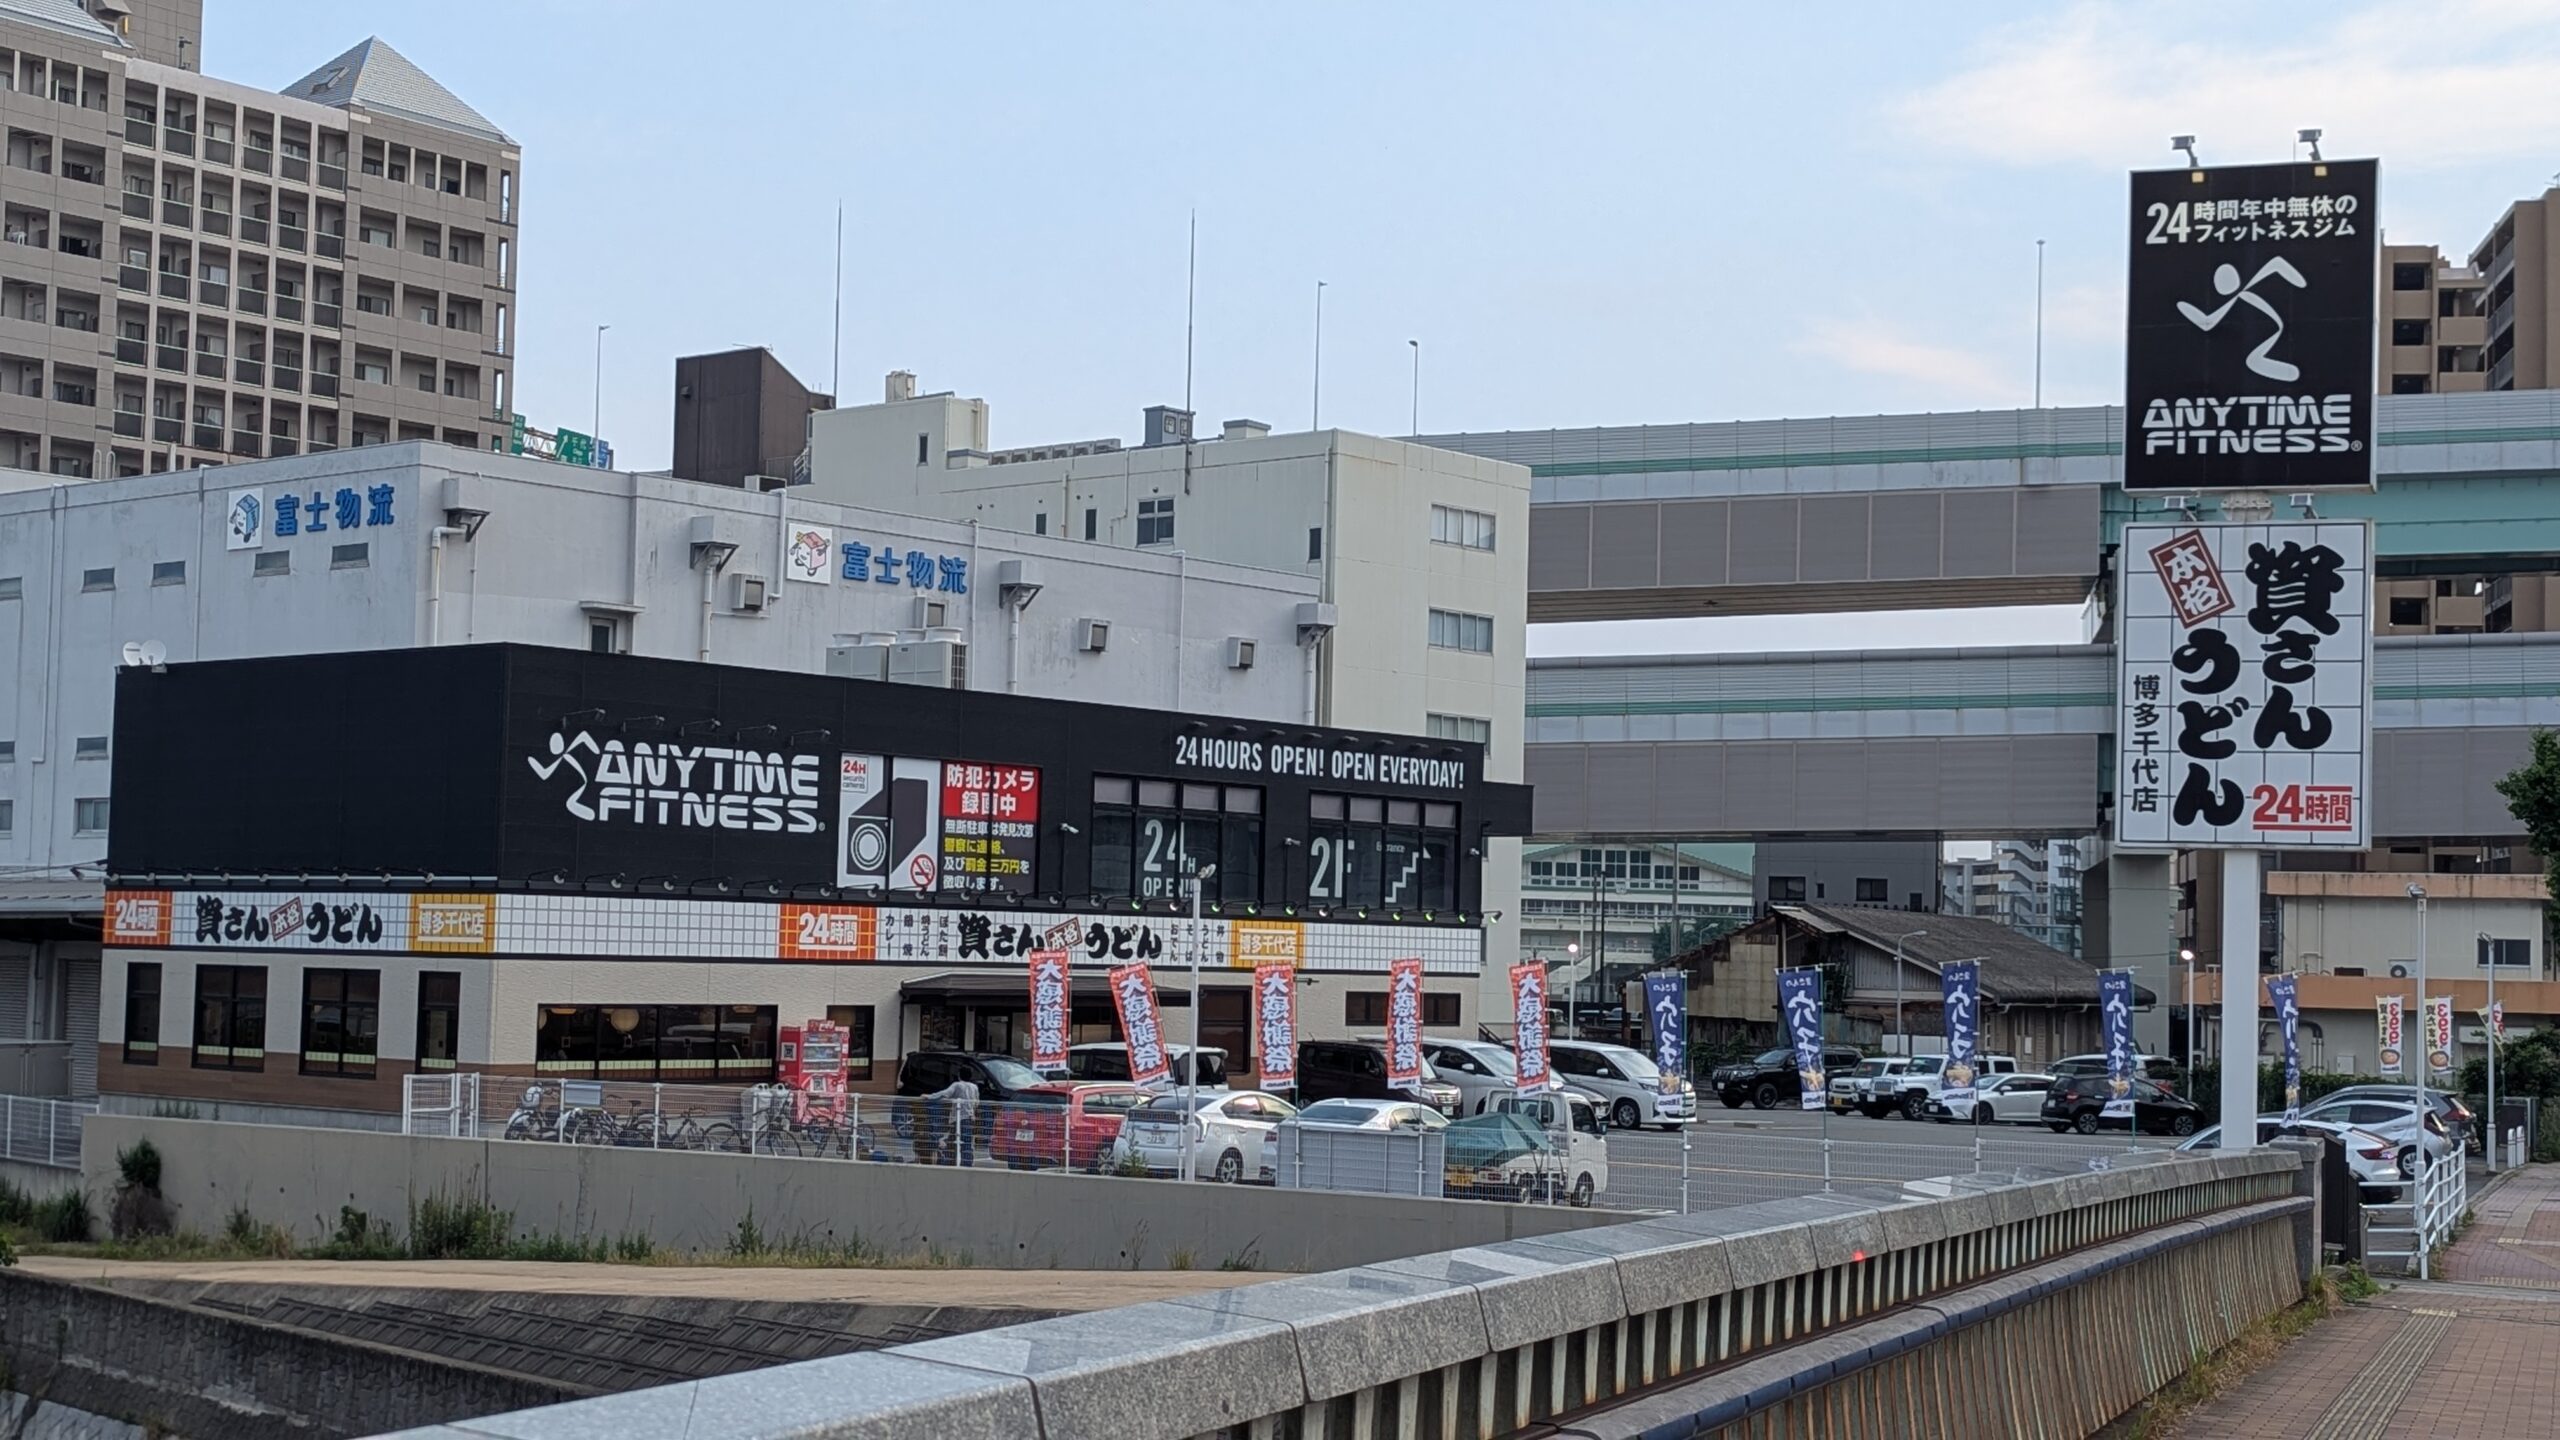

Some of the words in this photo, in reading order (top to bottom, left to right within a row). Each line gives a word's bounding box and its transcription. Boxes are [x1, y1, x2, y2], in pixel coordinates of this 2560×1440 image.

[2146, 201, 2190, 245] 24
[2194, 194, 2358, 221] 時間年中無休の
[2194, 219, 2356, 243] フィットネスジム
[2142, 394, 2351, 428] ANYTIME
[2146, 428, 2351, 455] FITNESS
[274, 483, 395, 537] 富士物流
[841, 541, 968, 594] 富士物流
[2163, 543, 2222, 617] 本格
[2246, 541, 2345, 750] 資さん
[2131, 674, 2161, 813] 博多千代店
[2171, 628, 2250, 827] うどん
[595, 740, 820, 797] ANYTIME
[843, 760, 867, 774] 24H
[946, 764, 1035, 792] 防犯カメラ
[1176, 735, 1198, 766] 24
[1201, 738, 1263, 772] HOURS
[1271, 745, 1324, 776] OPEN!
[1332, 750, 1375, 781] OPEN
[1380, 755, 1464, 789] EVERYDAY!
[599, 788, 818, 833] FITNESS
[961, 791, 1017, 816] 録画中
[2253, 784, 2353, 825] 24時間
[196, 895, 269, 944] 資さん
[306, 902, 383, 944] うどん
[418, 910, 485, 936] 博多千代店
[799, 912, 857, 946] 24時間
[885, 913, 895, 957] カレー
[957, 912, 1045, 960] 資さん
[1085, 922, 1163, 960] うどん
[1201, 924, 1209, 963] うどん
